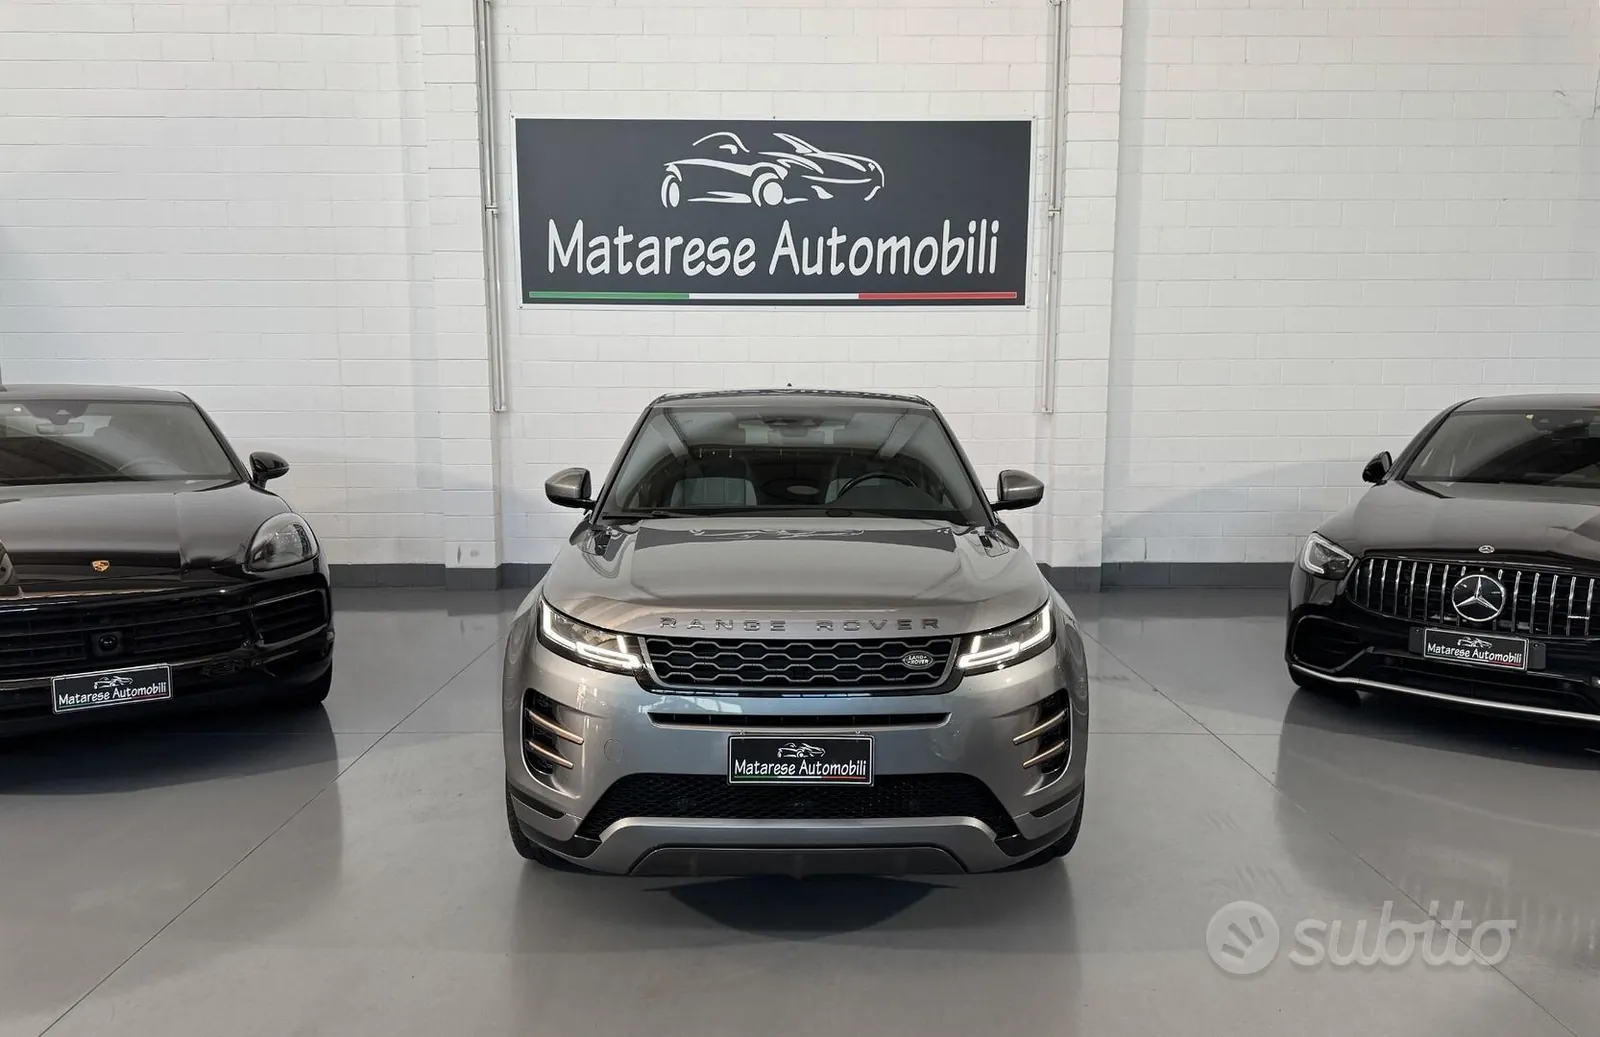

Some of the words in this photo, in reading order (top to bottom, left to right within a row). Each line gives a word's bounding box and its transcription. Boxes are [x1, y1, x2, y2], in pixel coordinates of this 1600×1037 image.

[547, 219, 757, 276] Matarese
[768, 218, 1000, 277] Automobili
[659, 616, 787, 632] RANGE
[816, 617, 941, 632] ROVER
[1427, 643, 1470, 657] Matarese
[1472, 648, 1522, 663] Automobili
[58, 691, 110, 705] Matarese
[112, 682, 167, 698] Automobili
[734, 758, 796, 776] Matarese
[798, 758, 867, 777] Automobili
